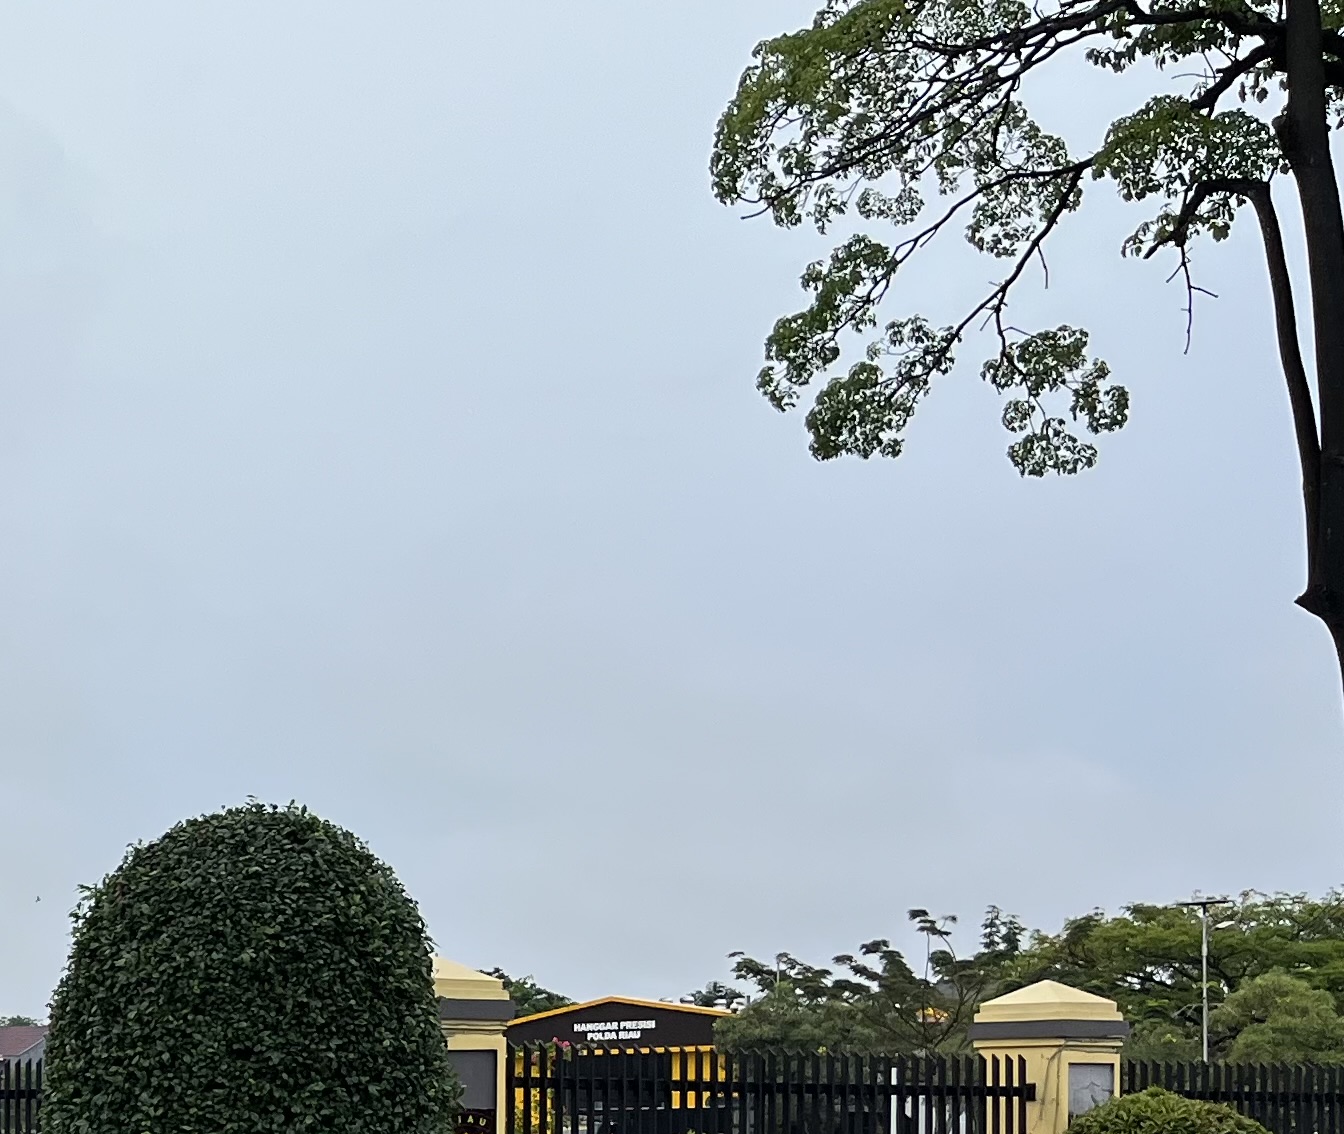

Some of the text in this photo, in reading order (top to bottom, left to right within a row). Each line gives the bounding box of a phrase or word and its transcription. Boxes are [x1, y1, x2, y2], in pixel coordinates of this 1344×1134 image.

[573, 1021, 619, 1032] HANGGAR
[586, 1030, 642, 1041] POLDA RIAU
[457, 1114, 487, 1126] IAU
